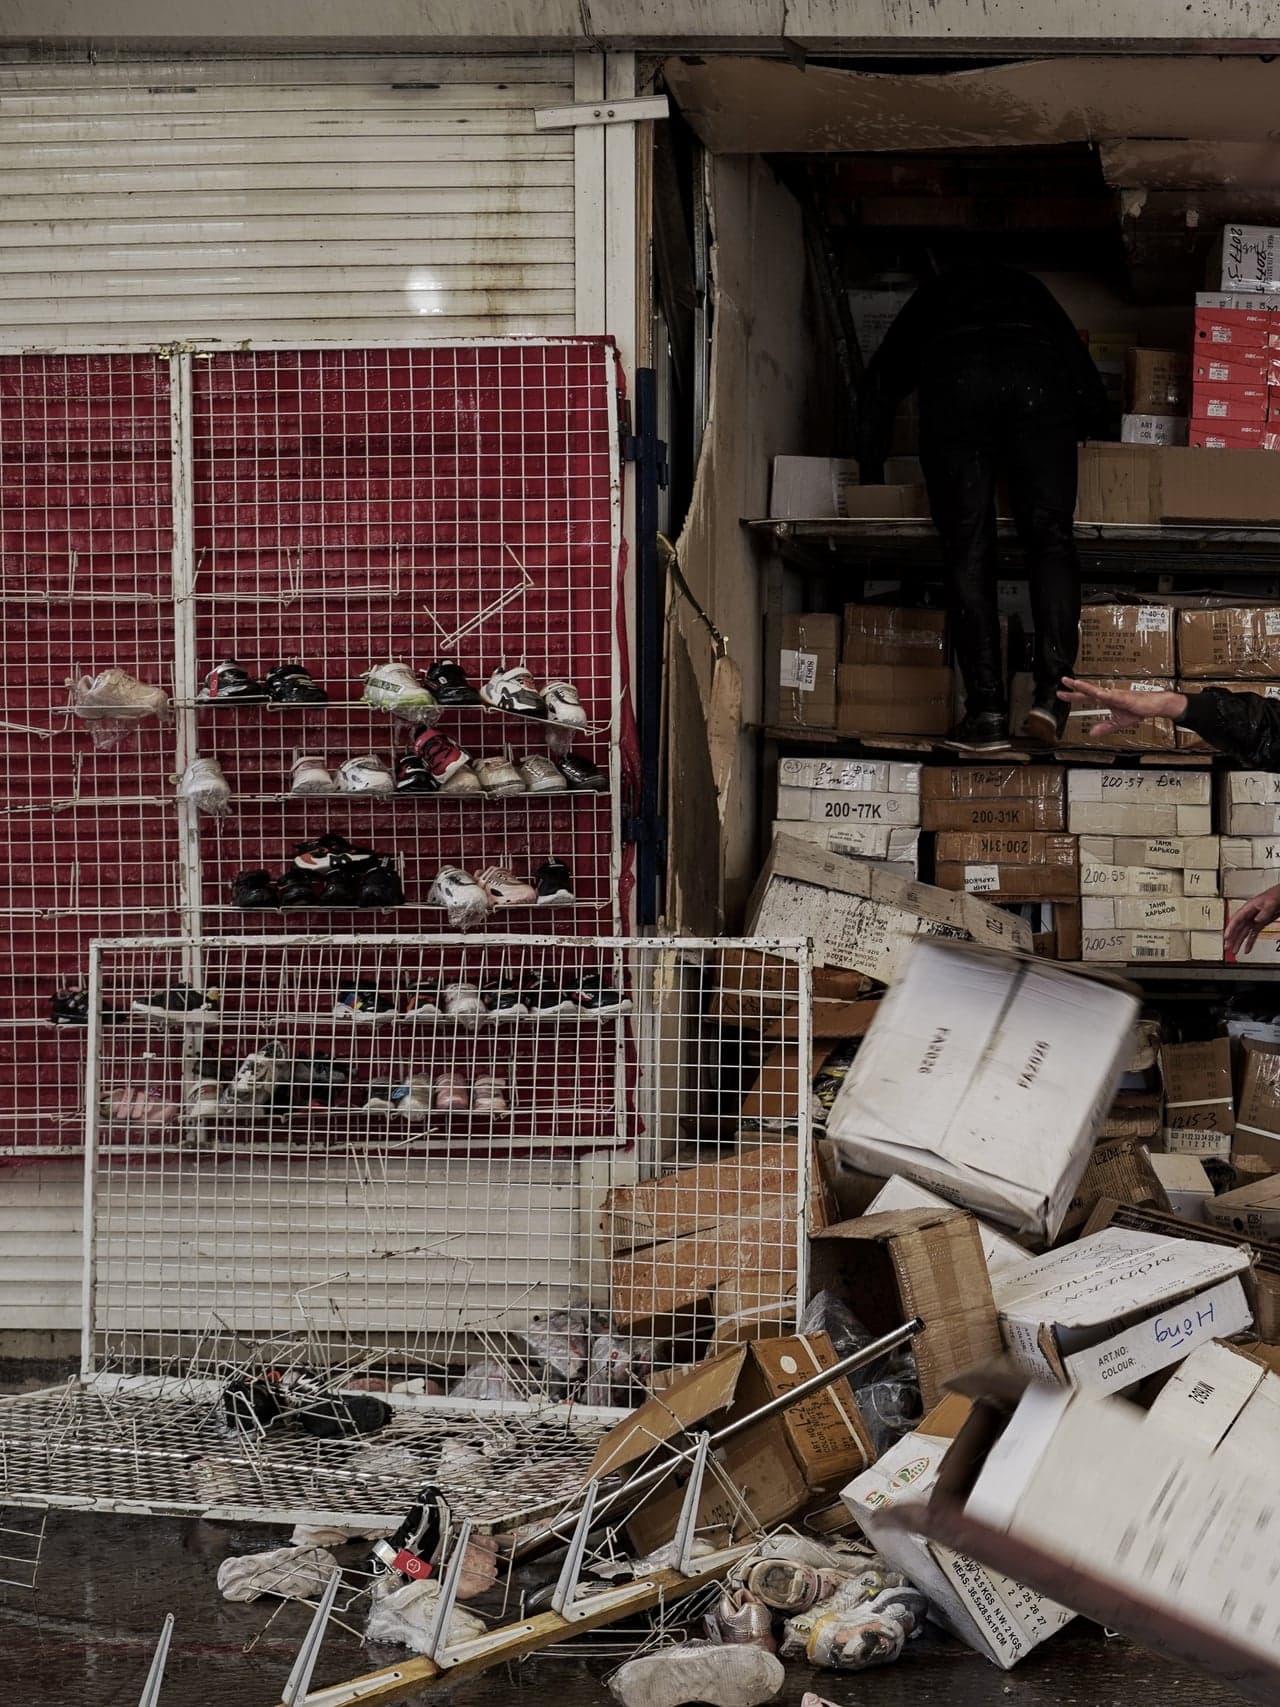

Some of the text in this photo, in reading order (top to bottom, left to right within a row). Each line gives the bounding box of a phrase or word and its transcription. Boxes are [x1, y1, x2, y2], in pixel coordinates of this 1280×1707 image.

[1101, 775, 1144, 788] 200-57
[825, 802, 881, 819] 200-77K
[1097, 1345, 1129, 1367] ART.NO:
[1101, 1357, 1137, 1380] COLOUR:
[952, 1560, 970, 1587] MEAS:
[995, 1632, 1007, 1646] CM
[1023, 1592, 1033, 1603] 25
[1030, 1604, 1039, 1615] 26
[1037, 1616, 1047, 1625] 27
[981, 1587, 995, 1606] KGS
[1009, 1632, 1022, 1650] KGS
